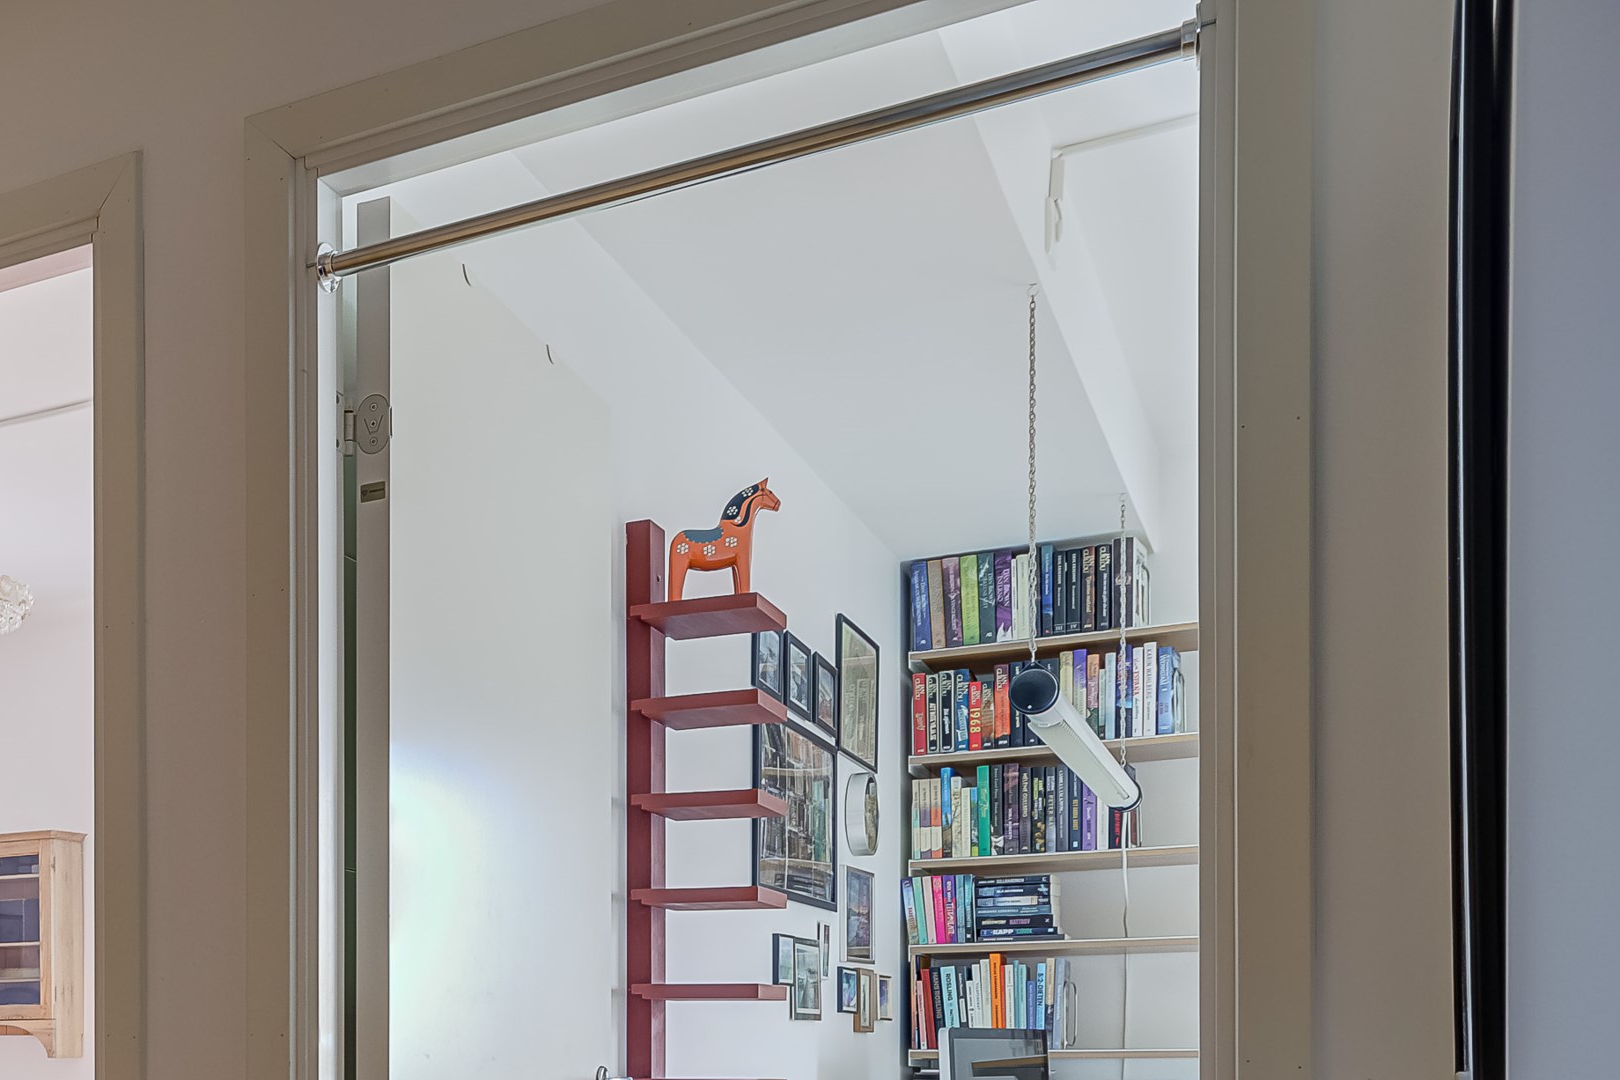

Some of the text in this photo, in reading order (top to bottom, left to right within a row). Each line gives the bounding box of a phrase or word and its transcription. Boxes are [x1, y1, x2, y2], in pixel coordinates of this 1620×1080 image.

[1002, 569, 1011, 607] DAN BROWN
[969, 707, 981, 734] 1968
[932, 972, 943, 1019] HANS ROSLING
[944, 973, 954, 1002] ROSLING
